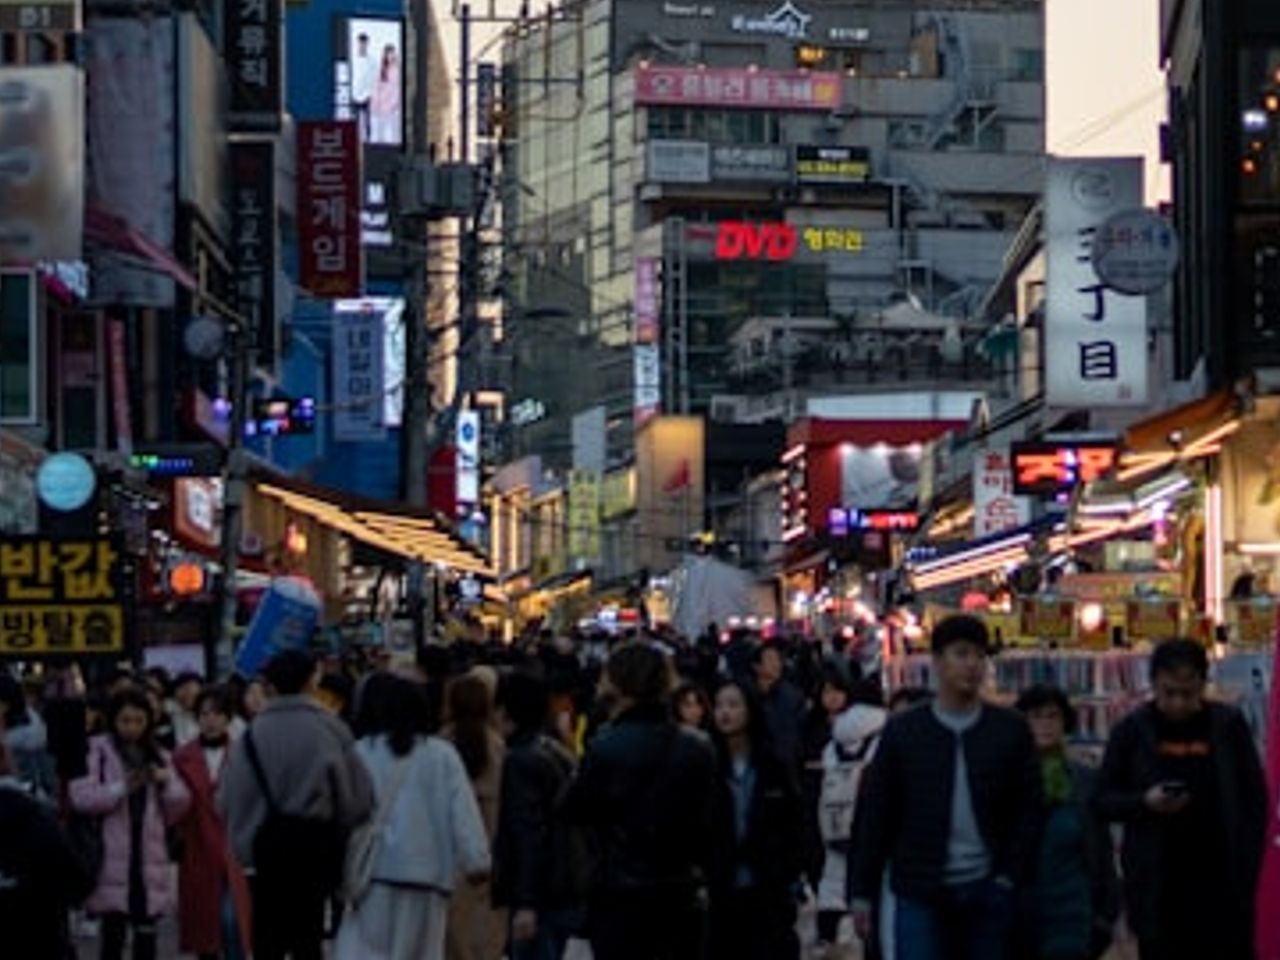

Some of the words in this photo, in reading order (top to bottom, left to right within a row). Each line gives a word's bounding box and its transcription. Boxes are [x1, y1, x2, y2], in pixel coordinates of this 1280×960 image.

[311, 127, 348, 271] 보드게임
[715, 220, 798, 259] DVD
[0, 541, 117, 600] 반값
[2, 609, 114, 649] 방탈출
